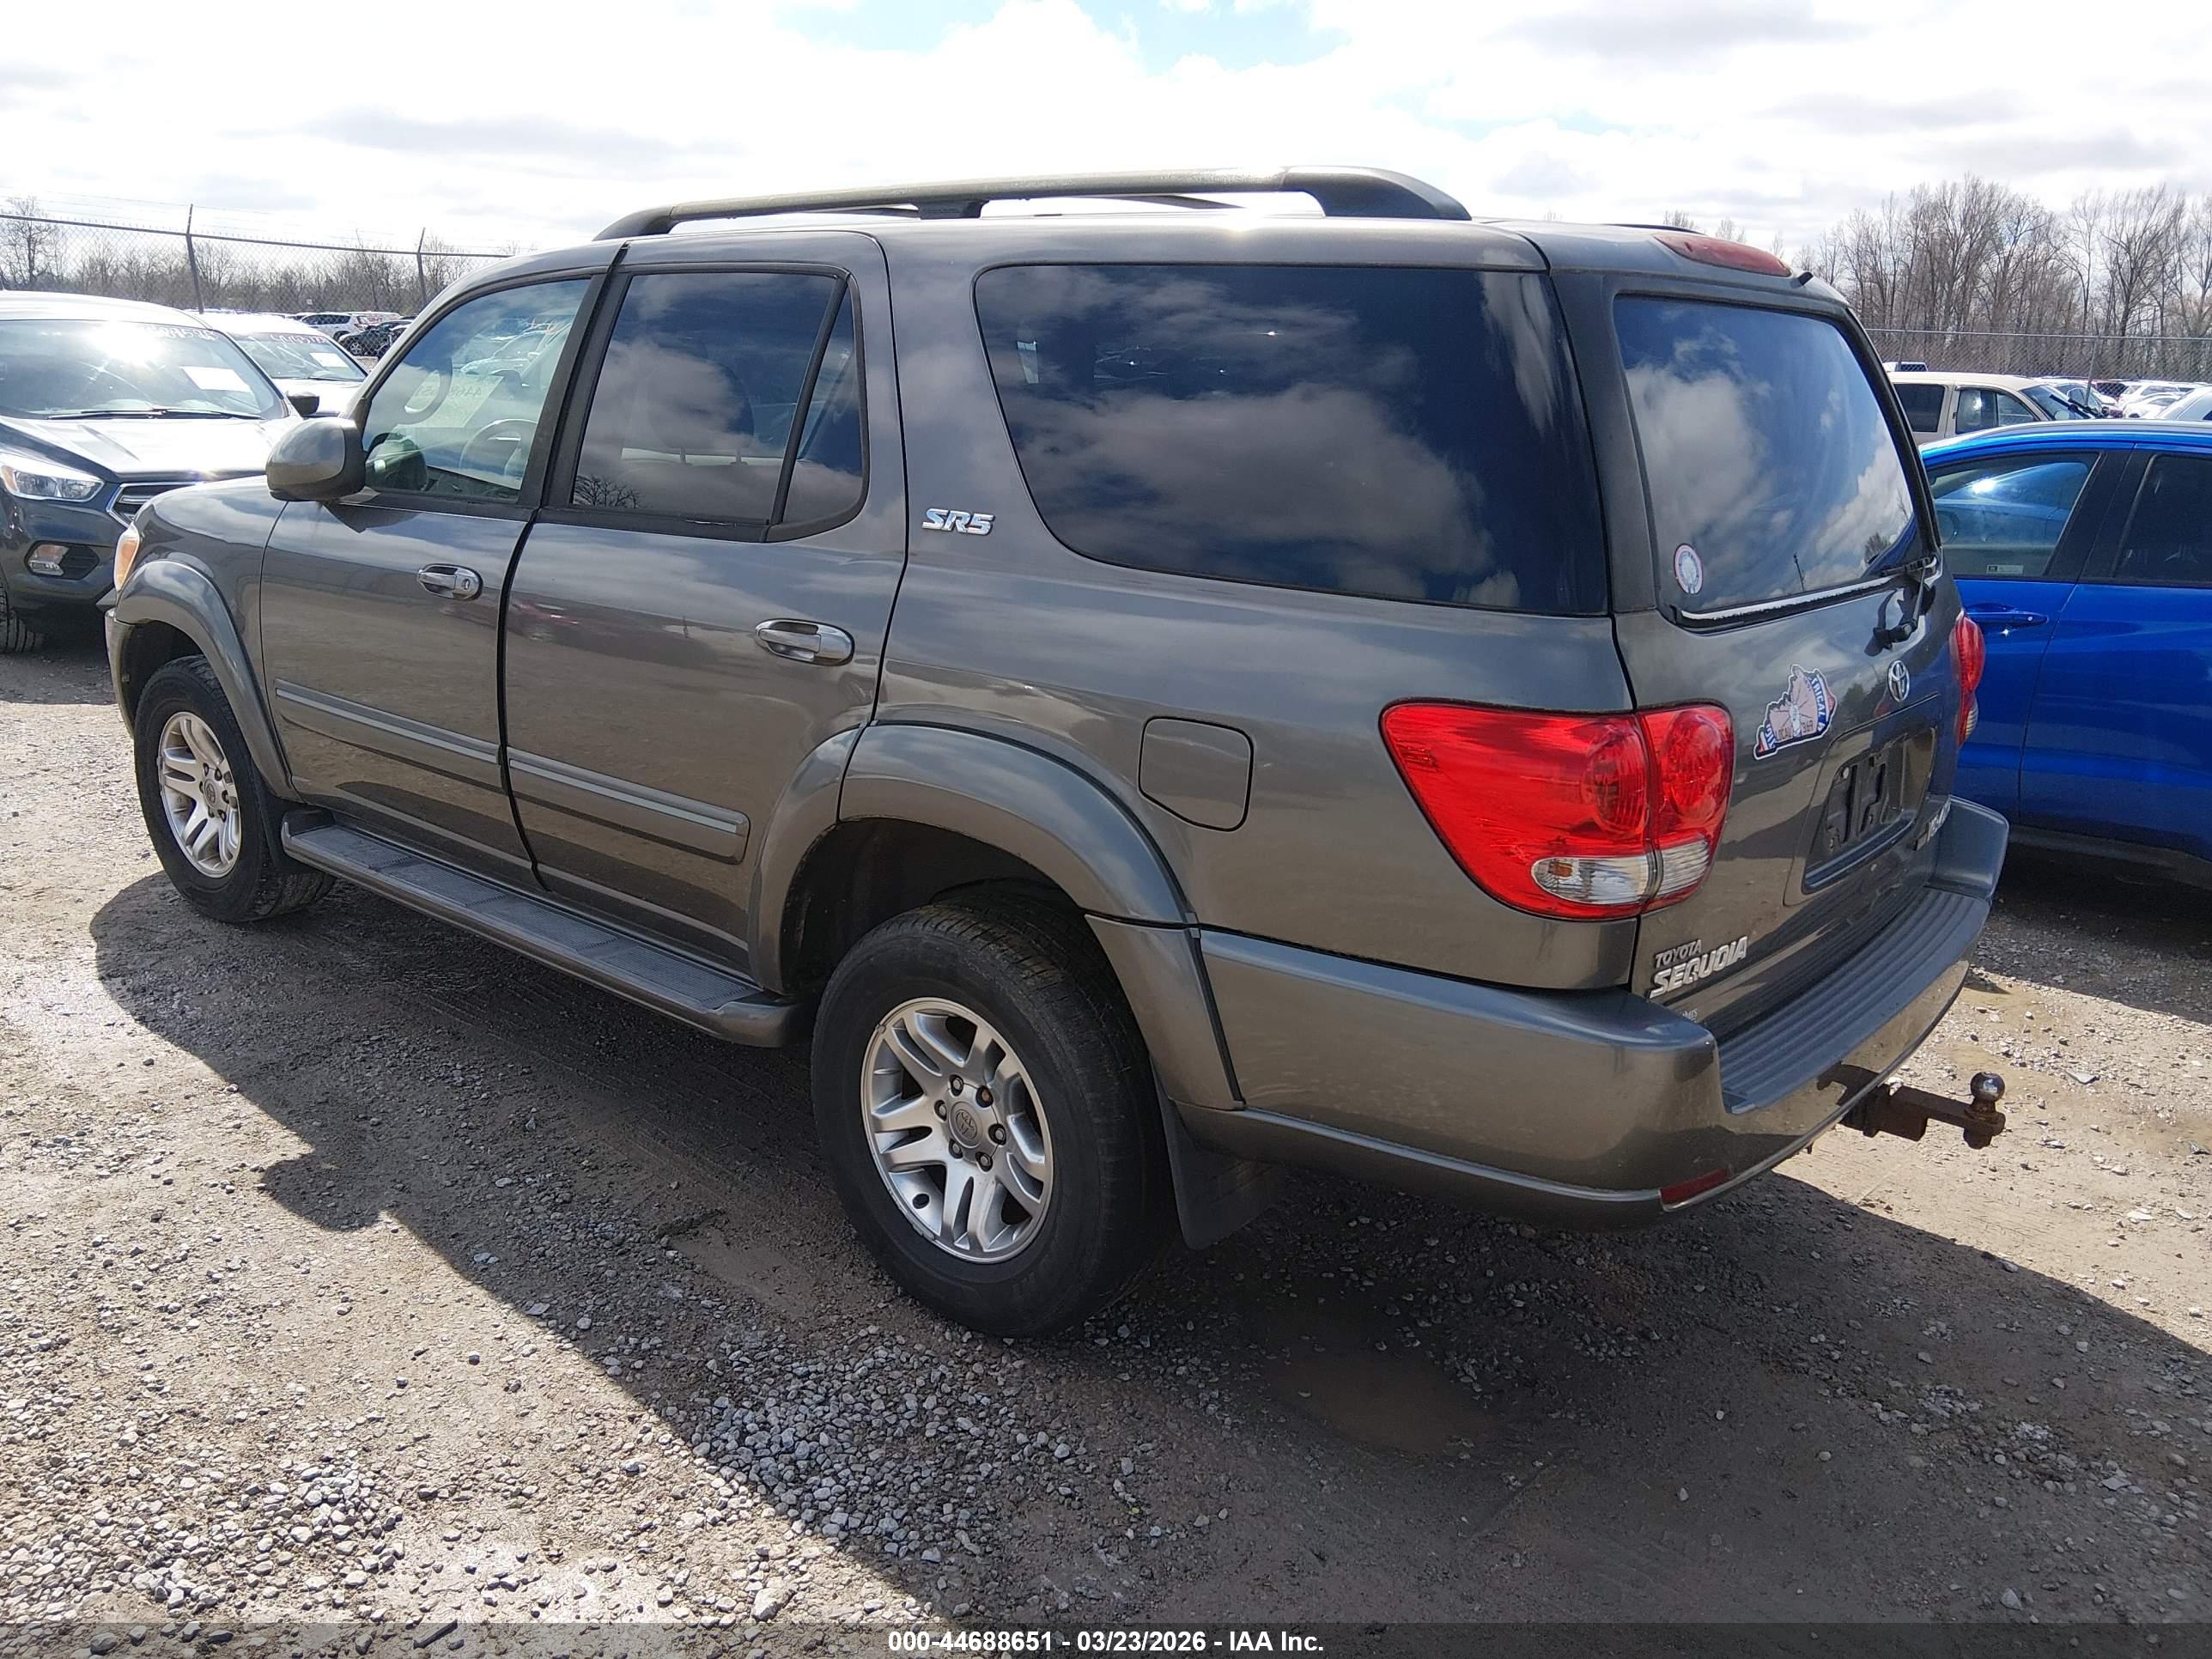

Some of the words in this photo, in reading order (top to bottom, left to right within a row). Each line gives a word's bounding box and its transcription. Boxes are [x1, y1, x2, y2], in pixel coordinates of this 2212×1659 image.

[922, 507, 995, 536] SR5
[1649, 935, 1747, 999] SEQUOIA
[1655, 939, 1702, 969] TOYOTA
